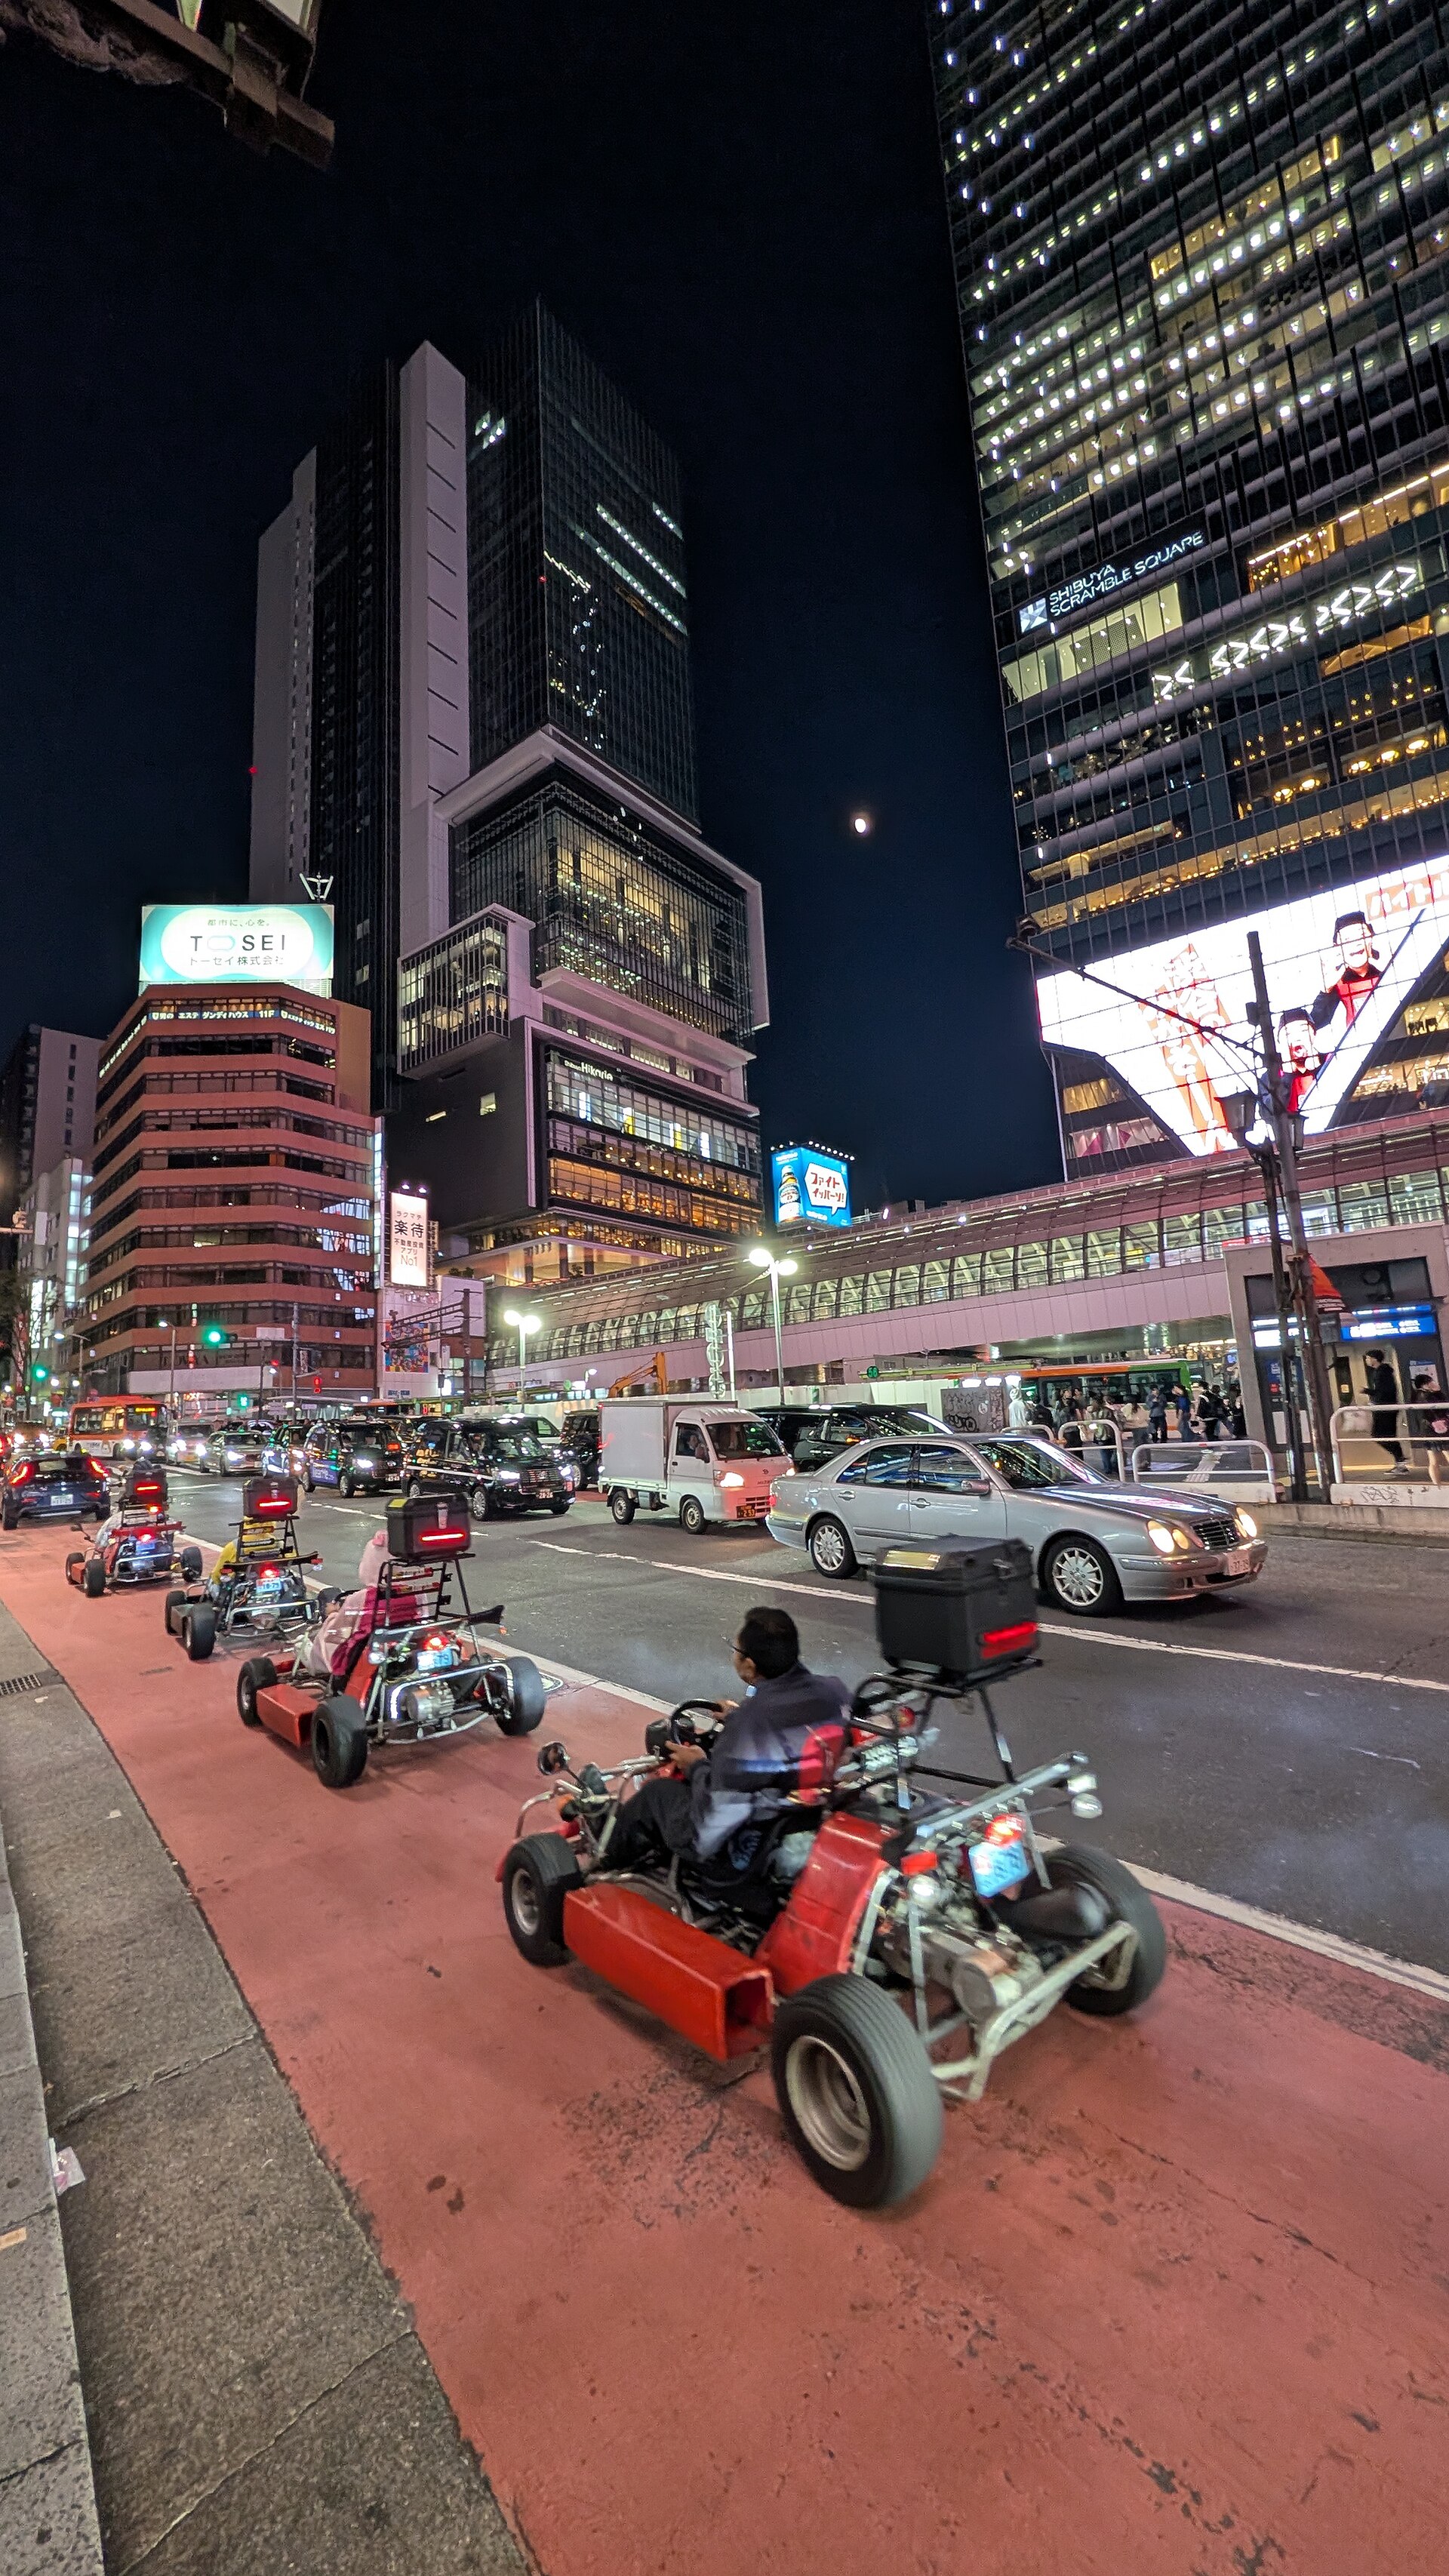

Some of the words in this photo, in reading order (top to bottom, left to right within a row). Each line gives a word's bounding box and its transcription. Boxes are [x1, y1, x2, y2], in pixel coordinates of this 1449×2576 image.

[1050, 568, 1133, 617] SCRAMBLE
[1134, 531, 1204, 576] SQUARE
[1049, 564, 1116, 605] SHIBUYA
[208, 919, 270, 927] 都市に、心を。
[190, 934, 285, 952] TOSEI
[190, 956, 285, 966] トーセイ株式会社
[259, 1010, 275, 1018] 11F
[580, 1061, 614, 1082] Hikarie
[810, 1172, 840, 1189] ファイト
[396, 1210, 422, 1220] ラクマチ
[394, 1220, 425, 1239] 楽待
[394, 1238, 424, 1249] 不動産投資
[401, 1247, 418, 1255] アプリ
